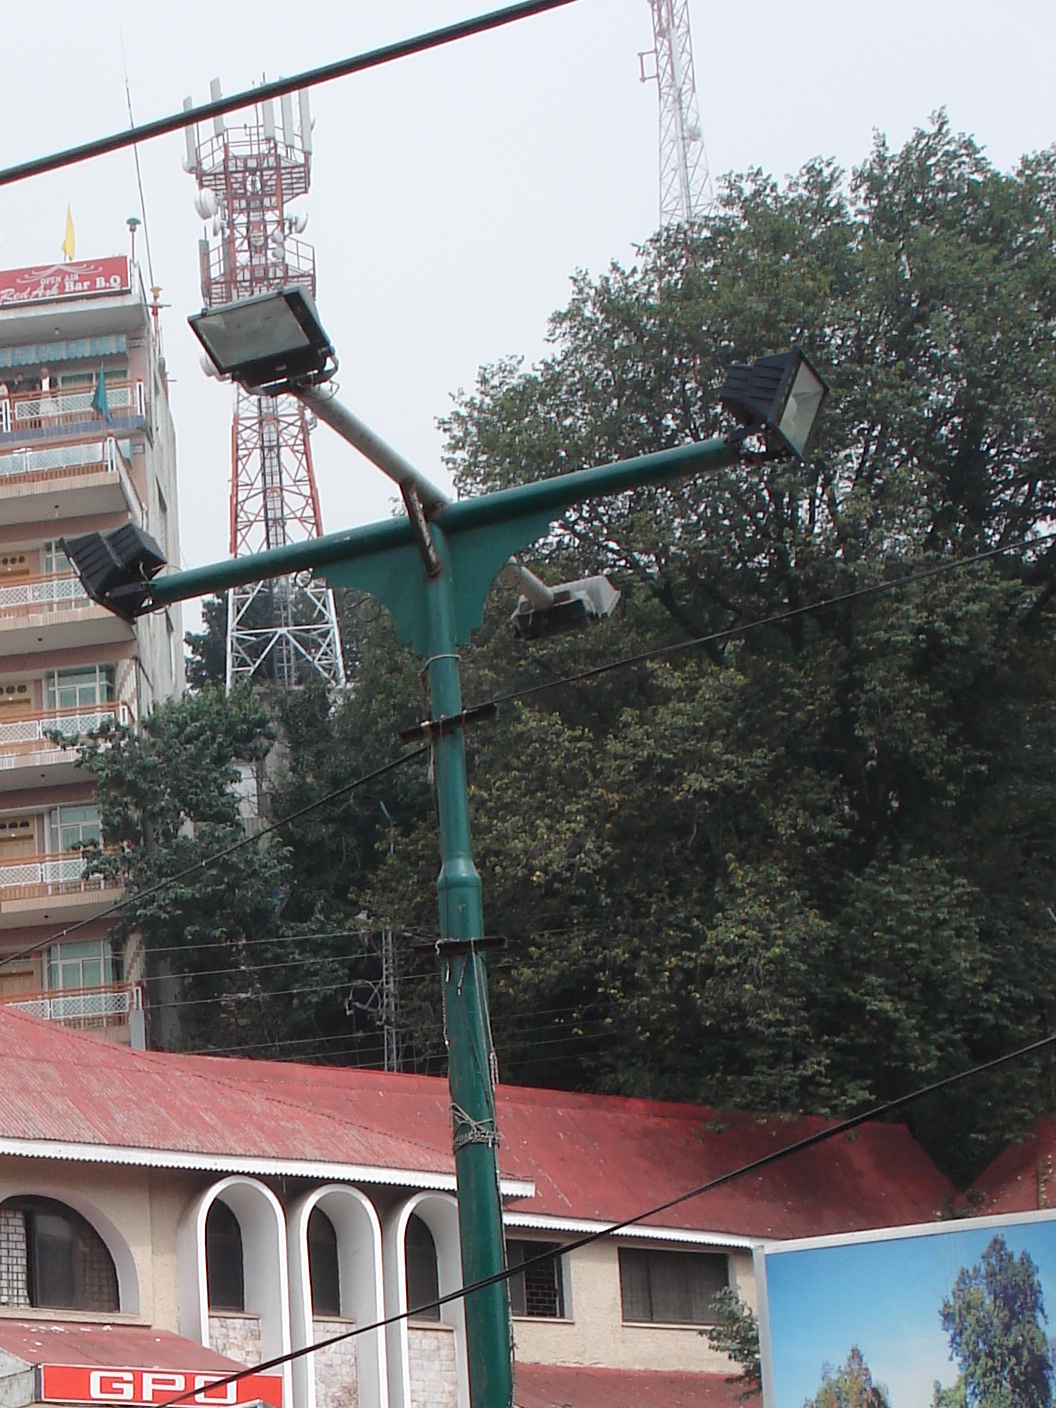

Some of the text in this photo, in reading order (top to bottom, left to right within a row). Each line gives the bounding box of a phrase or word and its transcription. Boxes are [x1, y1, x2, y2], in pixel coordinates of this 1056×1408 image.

[40, 273, 79, 285] OPEN AIR
[0, 286, 30, 302] Red
[65, 280, 91, 293] Bar
[89, 1370, 238, 1404] GPO
